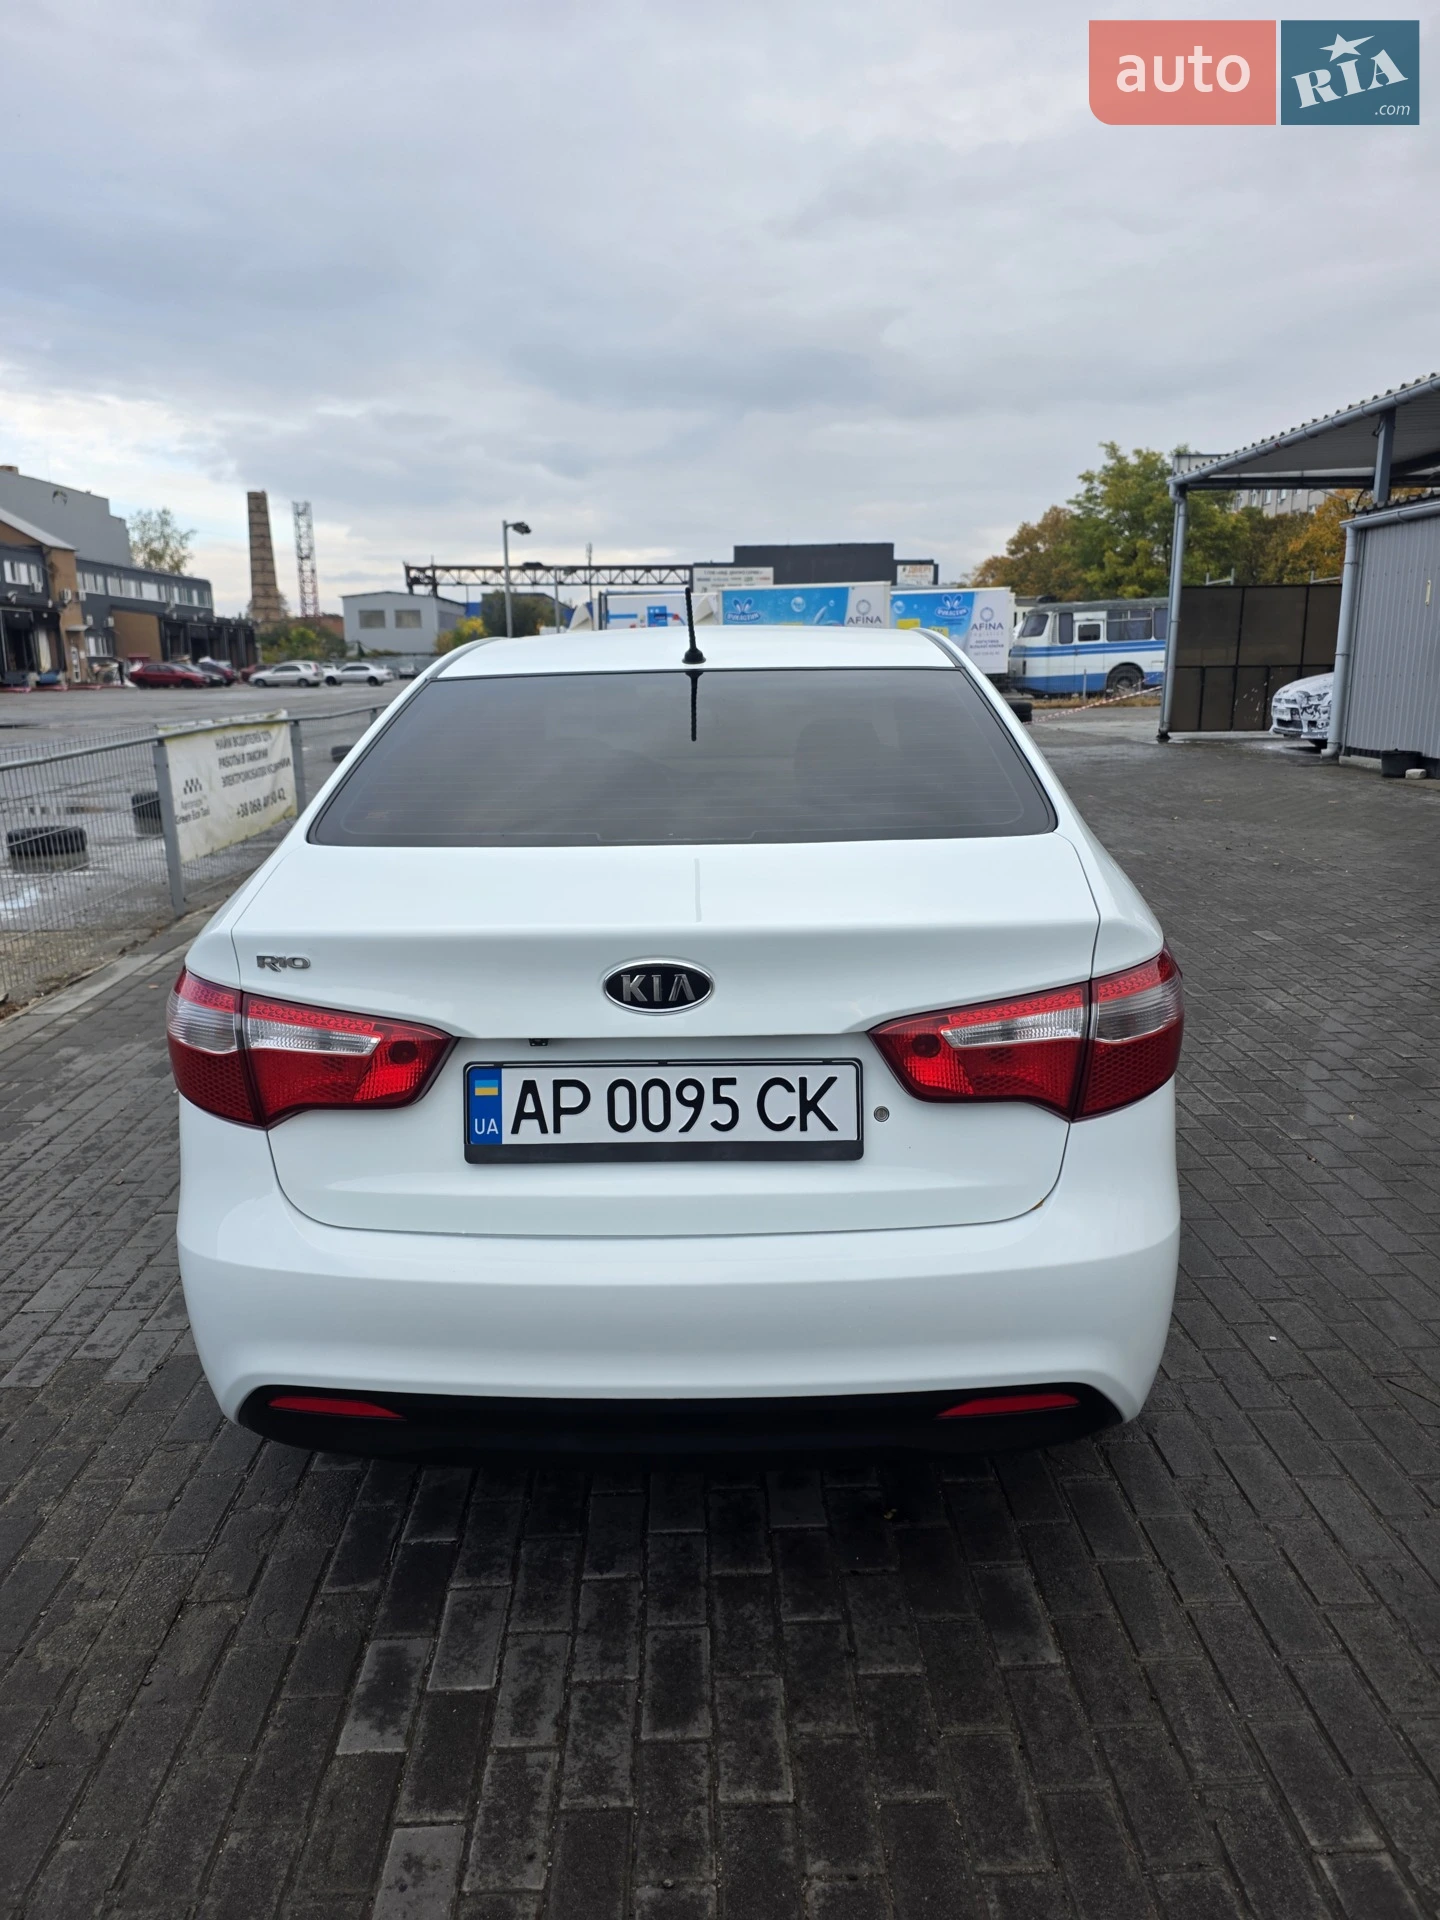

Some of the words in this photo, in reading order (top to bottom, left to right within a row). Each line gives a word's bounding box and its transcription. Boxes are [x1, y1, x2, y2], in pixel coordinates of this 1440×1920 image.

[619, 972, 697, 1003] KIA
[510, 1078, 592, 1135] AP
[605, 1077, 740, 1134] 0095
[756, 1075, 839, 1133] CK
[473, 1118, 499, 1136] UA
